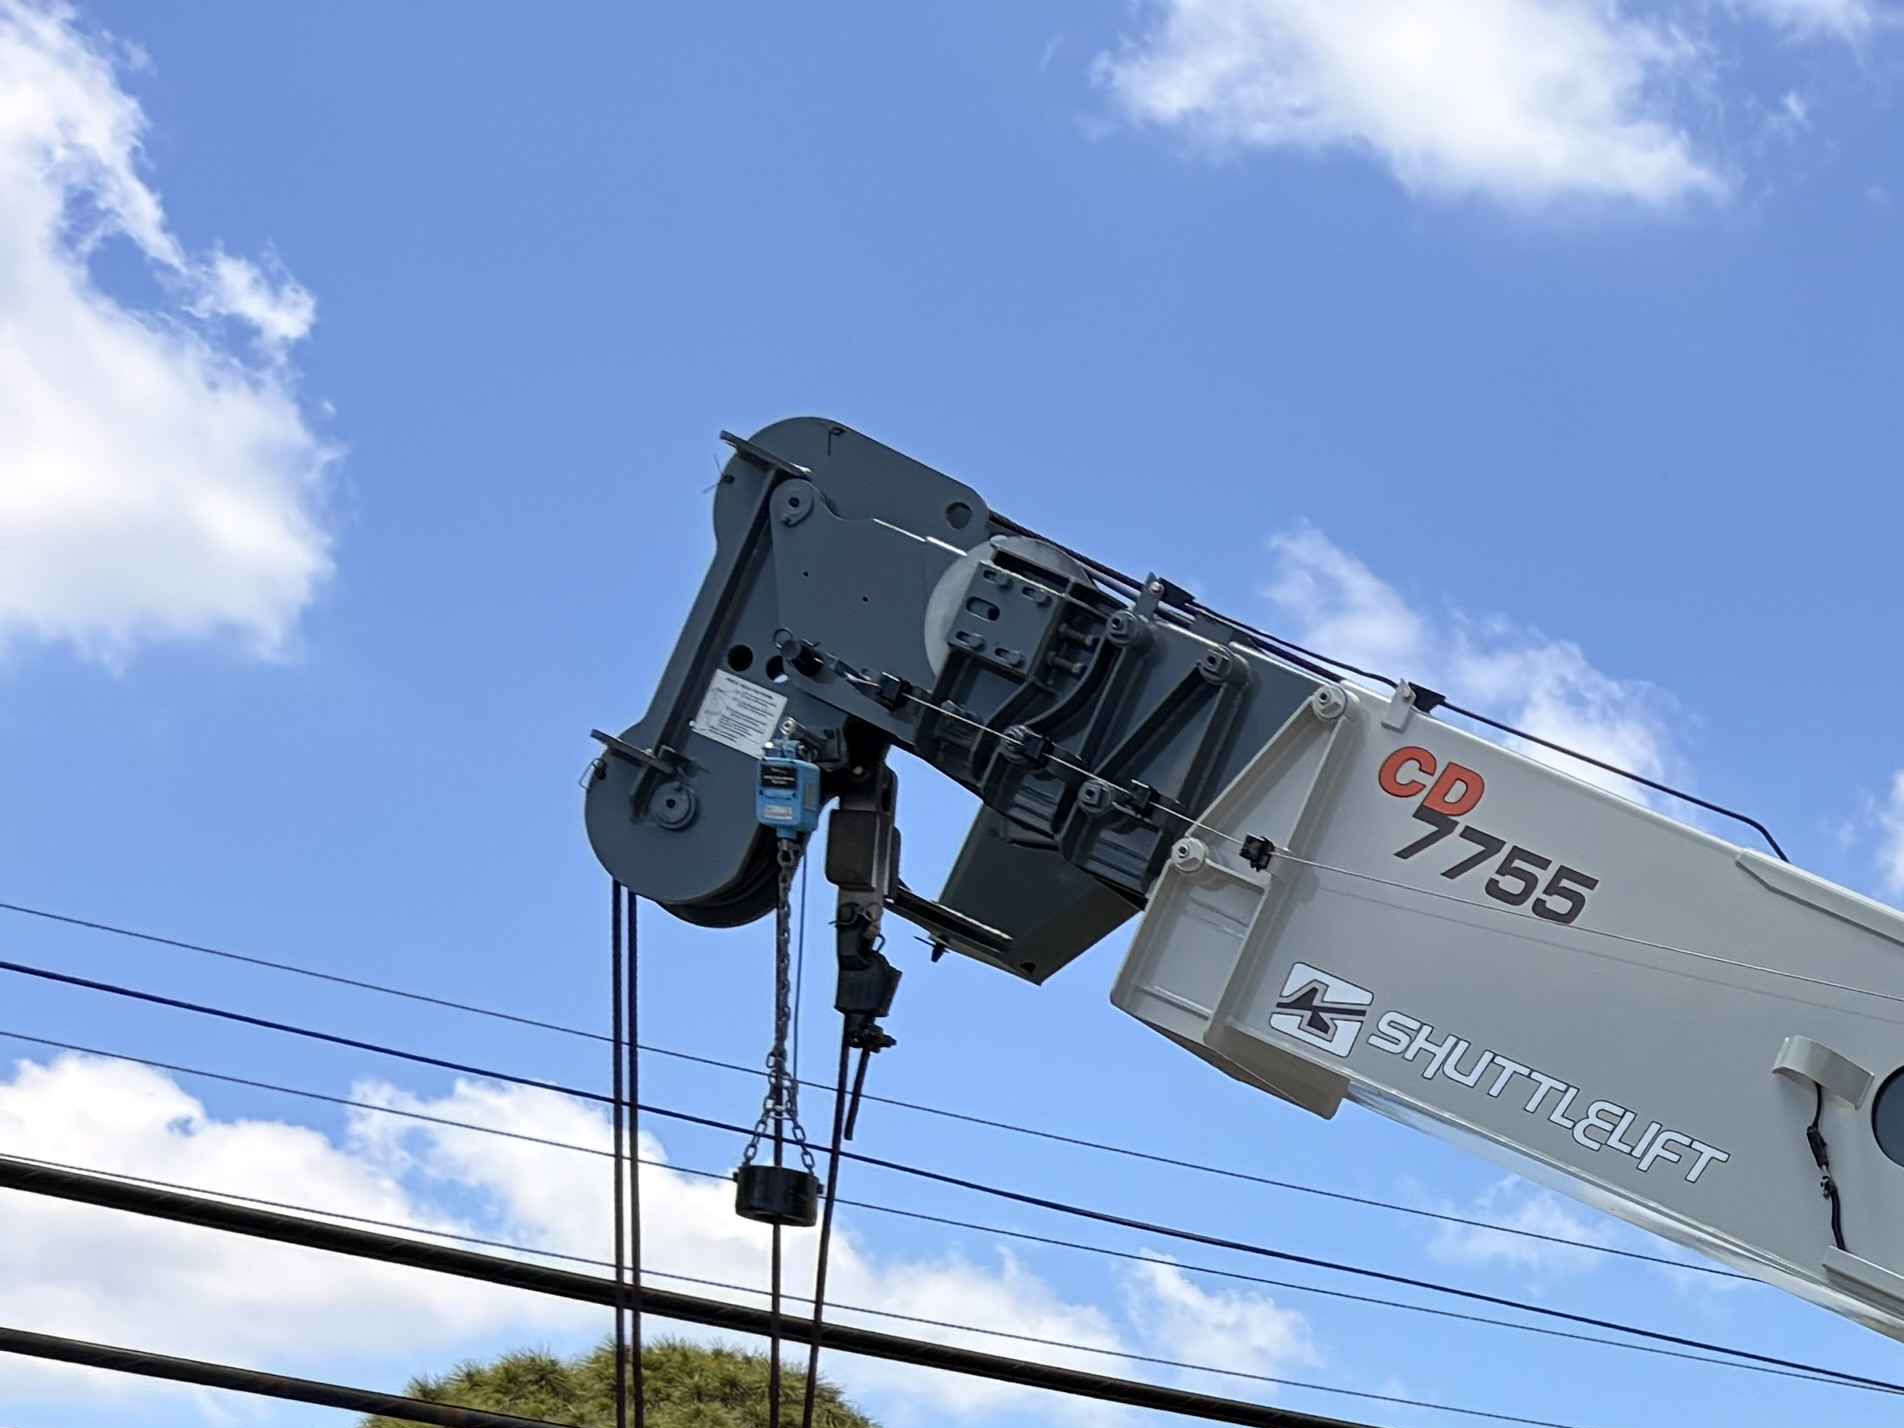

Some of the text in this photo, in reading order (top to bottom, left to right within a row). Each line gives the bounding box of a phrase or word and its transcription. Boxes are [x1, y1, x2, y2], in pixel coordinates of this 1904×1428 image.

[1378, 746, 1485, 816] CD
[1393, 804, 1599, 925] 7755
[1368, 1011, 1729, 1183] SHUTTLELIFT
